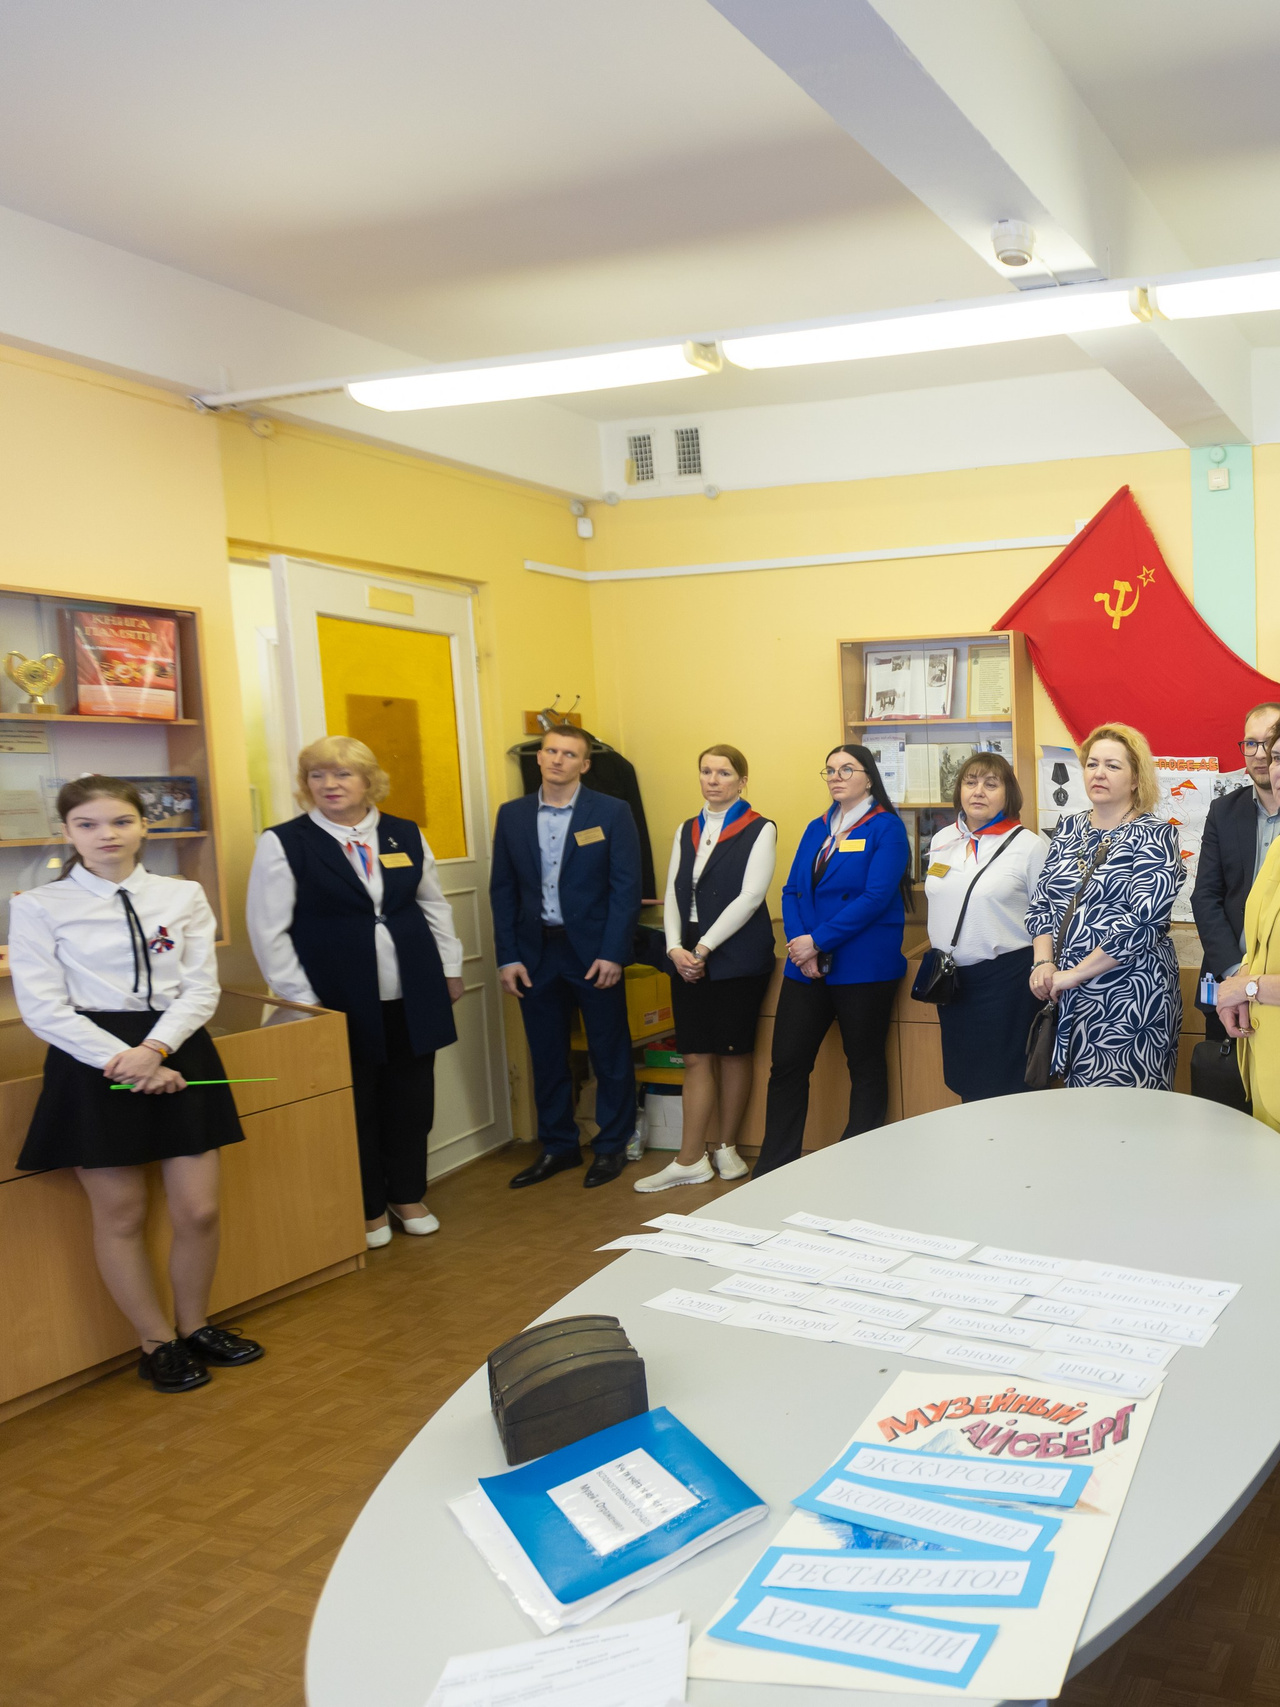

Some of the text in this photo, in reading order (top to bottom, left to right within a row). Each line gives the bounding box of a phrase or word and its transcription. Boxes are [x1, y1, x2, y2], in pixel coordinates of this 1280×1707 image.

[776, 1238, 832, 1255] никогда
[850, 1252, 891, 1264] весел
[992, 1254, 1061, 1269] уважает
[1117, 1273, 1204, 1294] Бережлив
[785, 1290, 806, 1302] не
[931, 1289, 998, 1306] всякому
[841, 1299, 909, 1320] правдив
[1035, 1304, 1075, 1315] брат
[751, 1310, 839, 1332] рабочему
[1131, 1319, 1180, 1334] Друг
[852, 1329, 905, 1342] верен
[946, 1345, 1016, 1364] пионер
[1056, 1362, 1124, 1384] Юный
[877, 1387, 1087, 1443] МУЗЕЙНЫЙ
[960, 1402, 1137, 1459] АЙСБЕРГ
[852, 1454, 1067, 1490] ЭКСКУРСОВОД
[579, 1483, 596, 1501] Музей
[826, 1486, 1028, 1542] ЭКСПОЗИЦИОНЕР
[777, 1562, 1020, 1590] РЕСТАВРАТОР
[752, 1606, 967, 1660] ХРАНИТЕЛИ
